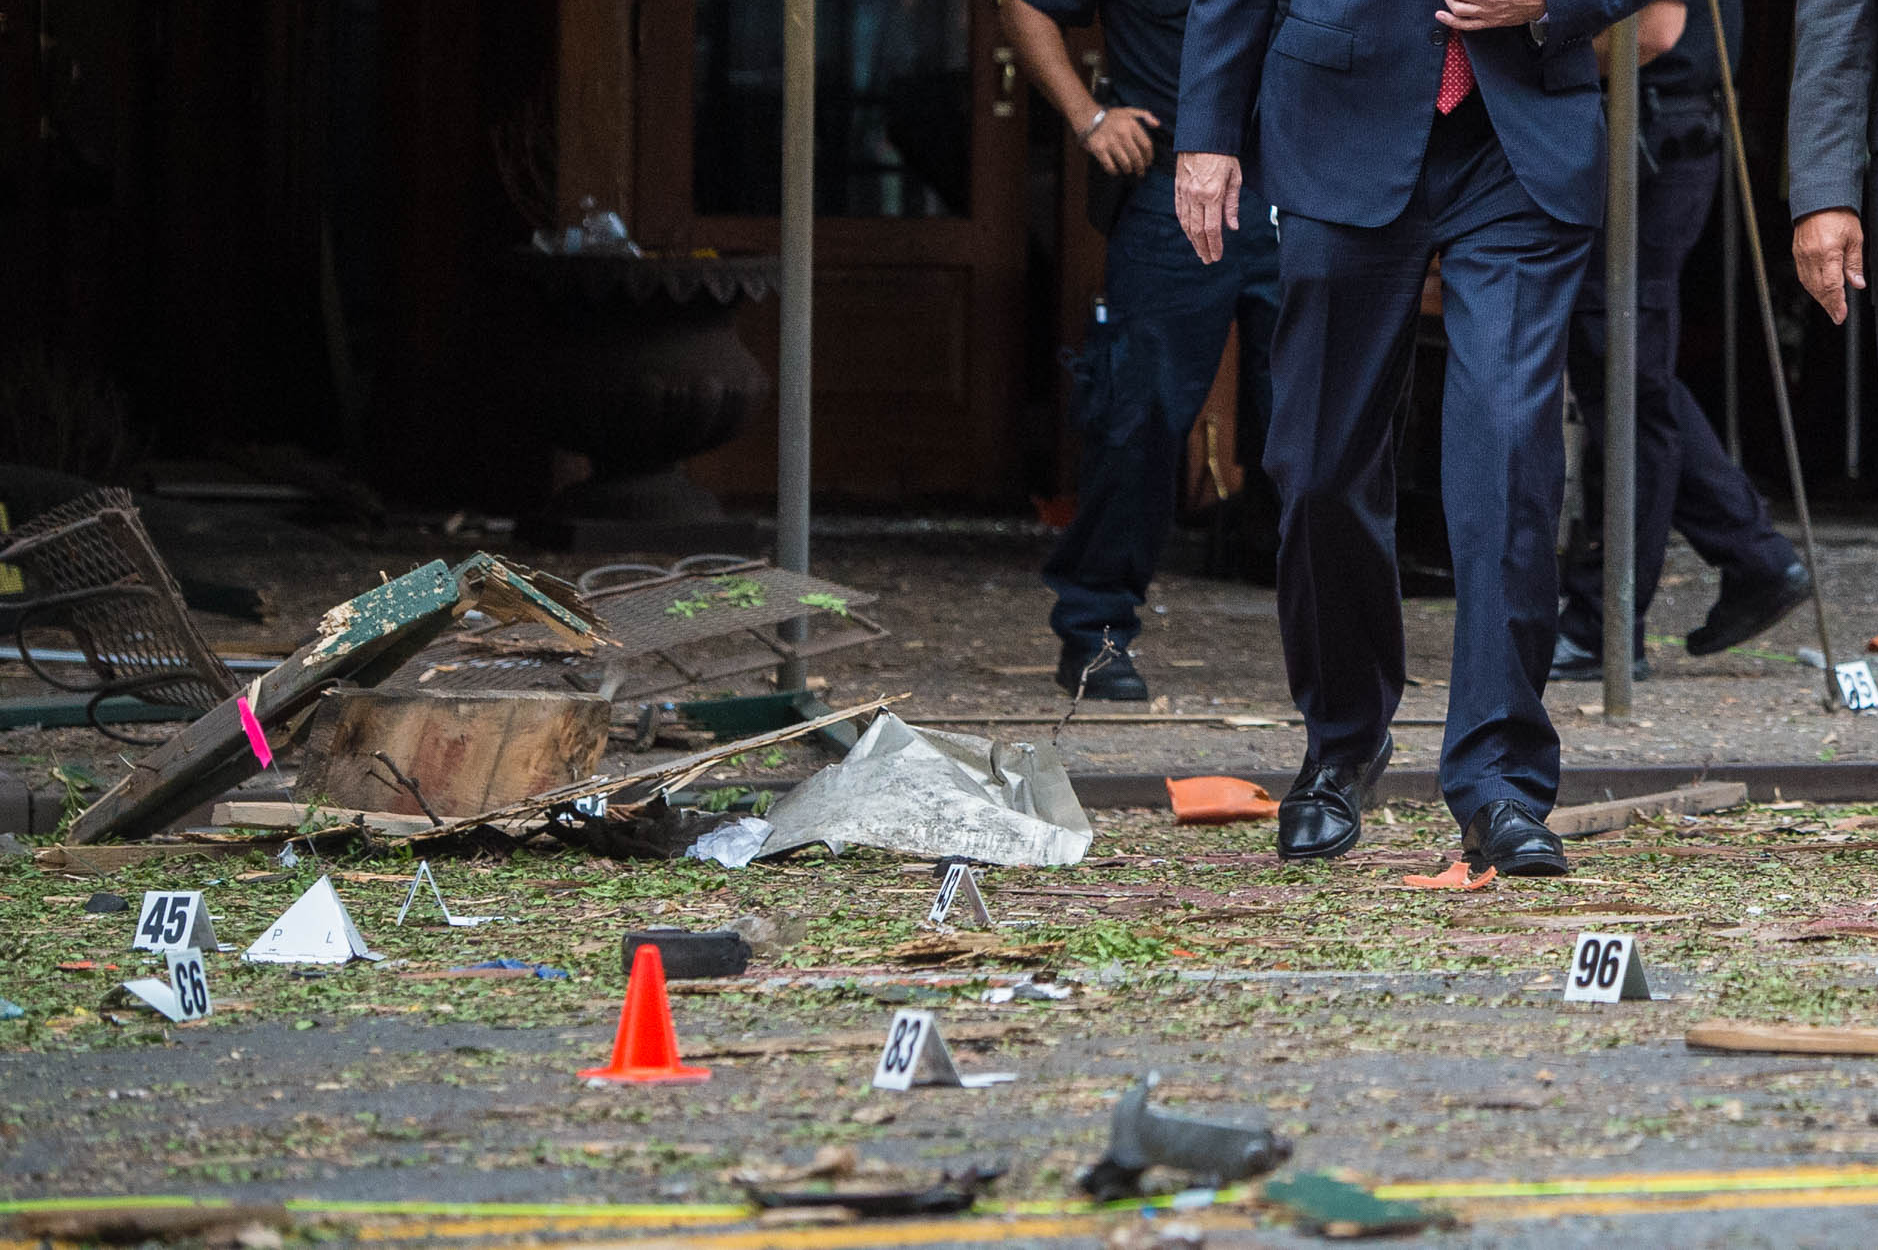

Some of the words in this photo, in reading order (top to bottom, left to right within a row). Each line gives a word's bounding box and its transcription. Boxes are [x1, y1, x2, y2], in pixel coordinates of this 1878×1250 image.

[936, 868, 960, 912] 43
[142, 897, 191, 944] 45
[1574, 938, 1623, 989] 96
[882, 1016, 922, 1075] 83
